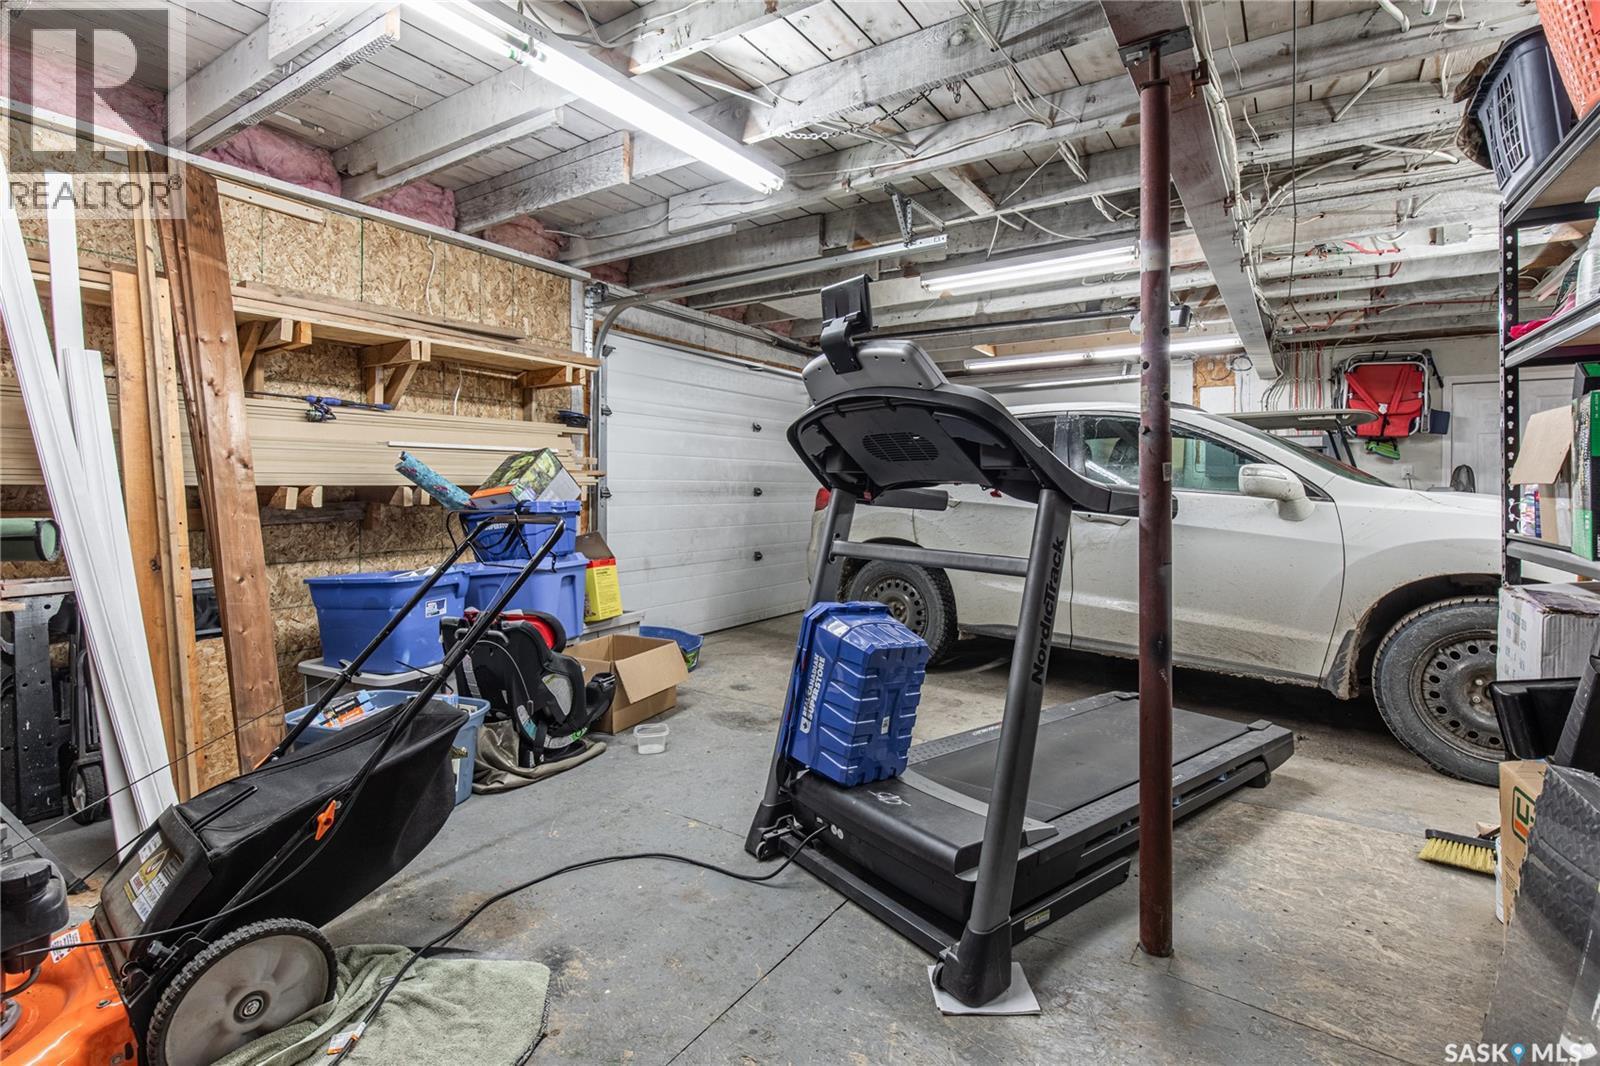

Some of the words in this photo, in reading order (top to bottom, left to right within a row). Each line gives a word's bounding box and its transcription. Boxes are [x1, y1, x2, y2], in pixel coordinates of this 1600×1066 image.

[1031, 536, 1065, 685] NordicTrack
[802, 697, 811, 717] REAL
[807, 652, 820, 696] CANADIAN
[807, 655, 826, 721] SUPERSTORE
